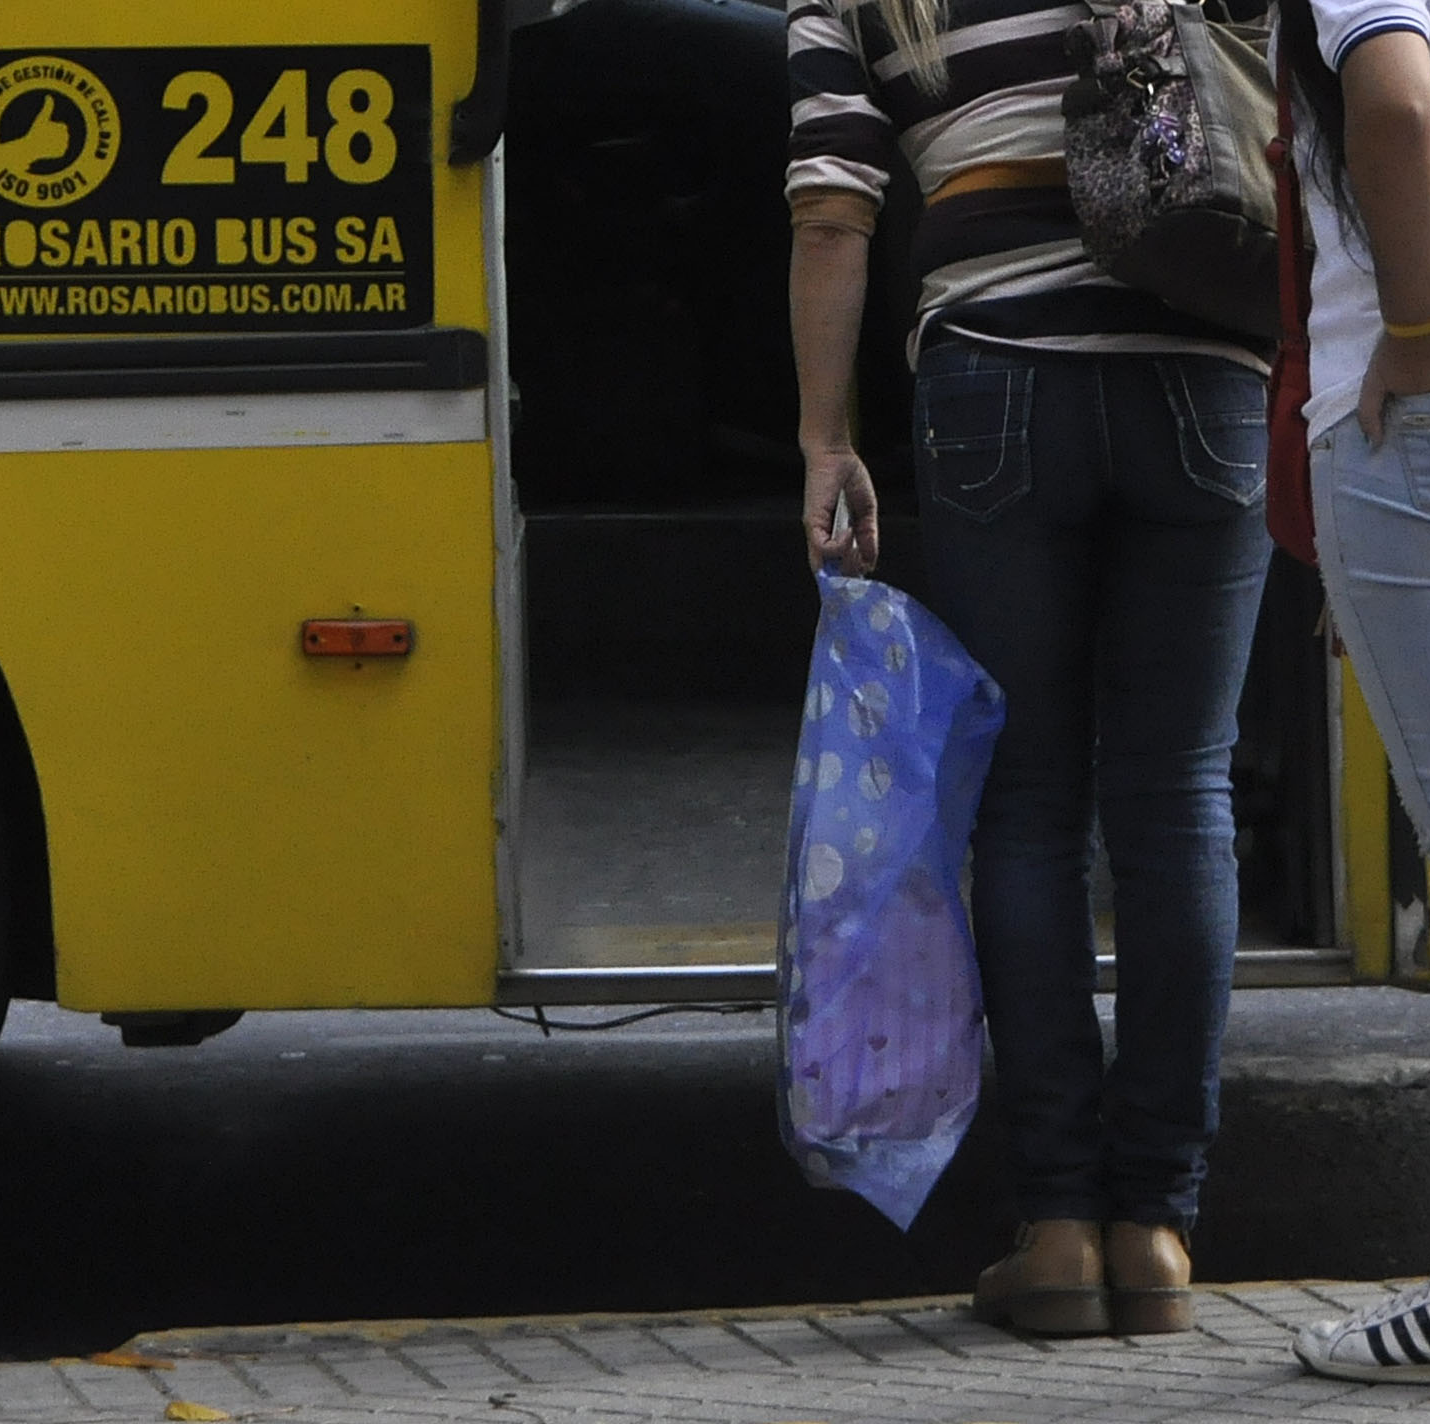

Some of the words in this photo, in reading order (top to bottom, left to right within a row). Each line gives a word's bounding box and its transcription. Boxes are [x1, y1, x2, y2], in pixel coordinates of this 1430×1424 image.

[160, 69, 398, 186] 248
[36, 170, 88, 200] 9001
[216, 218, 319, 267] BUS
[334, 216, 405, 265] SA
